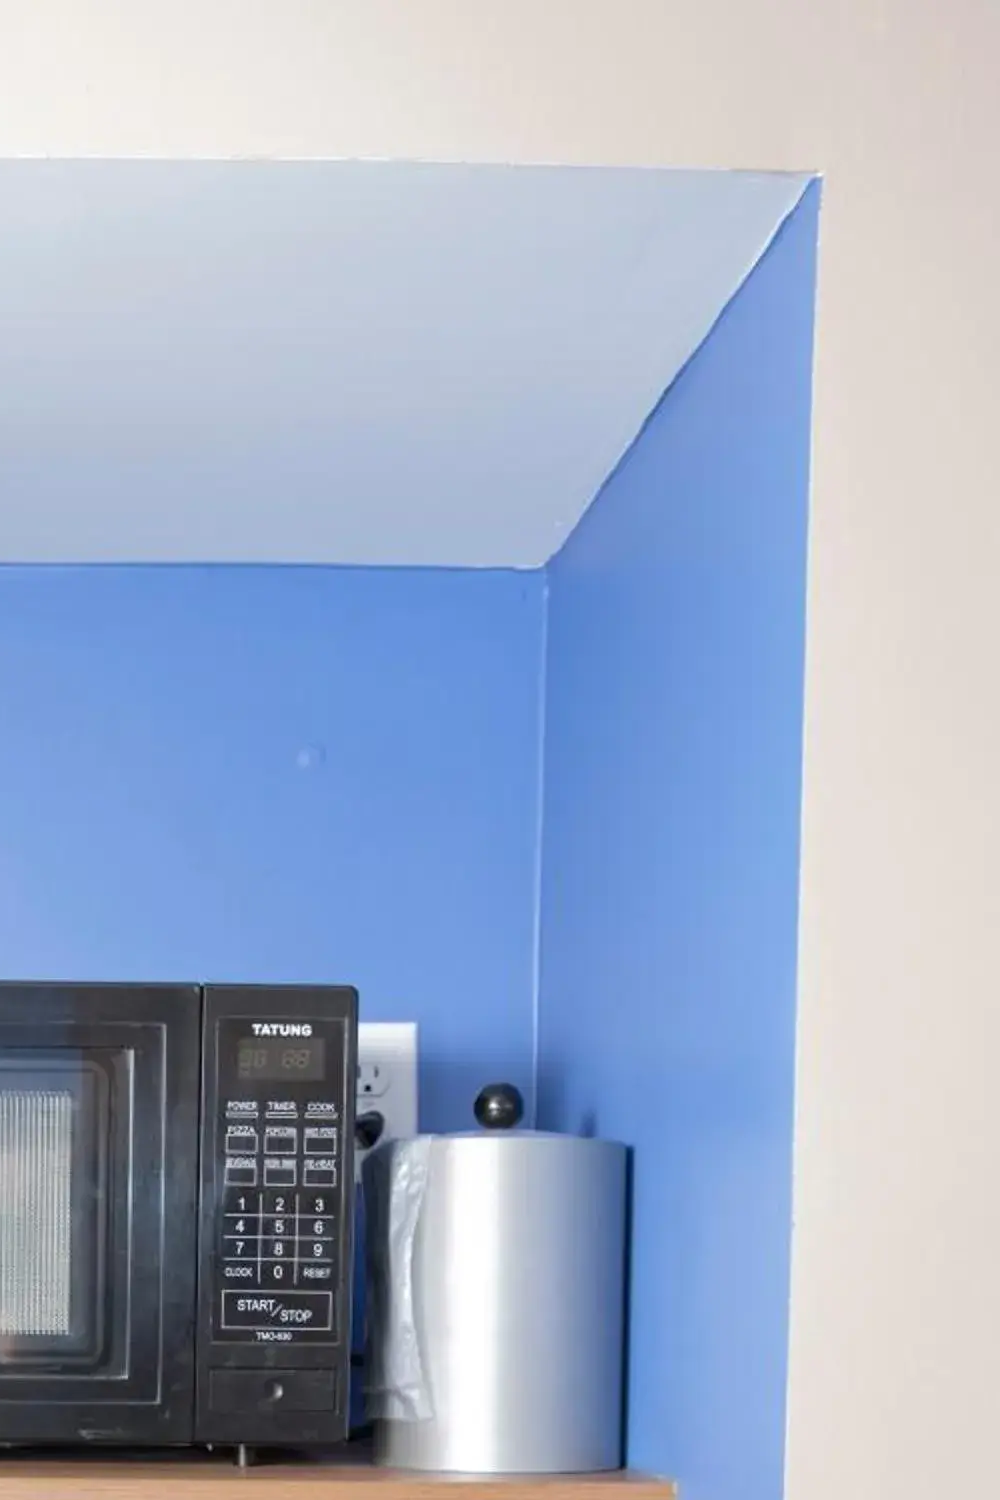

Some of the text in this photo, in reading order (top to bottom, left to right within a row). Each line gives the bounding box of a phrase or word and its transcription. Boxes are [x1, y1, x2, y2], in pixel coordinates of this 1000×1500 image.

[252, 1024, 313, 1037] TATUNG
[227, 1101, 258, 1111] POWER
[267, 1101, 297, 1112] TIMER
[307, 1103, 335, 1112] COOK
[238, 1197, 324, 1212] 1 2 3
[235, 1219, 324, 1234] 4 5 6
[235, 1242, 323, 1257] 7 8 9
[224, 1266, 331, 1279] CLOCK 0 RESET
